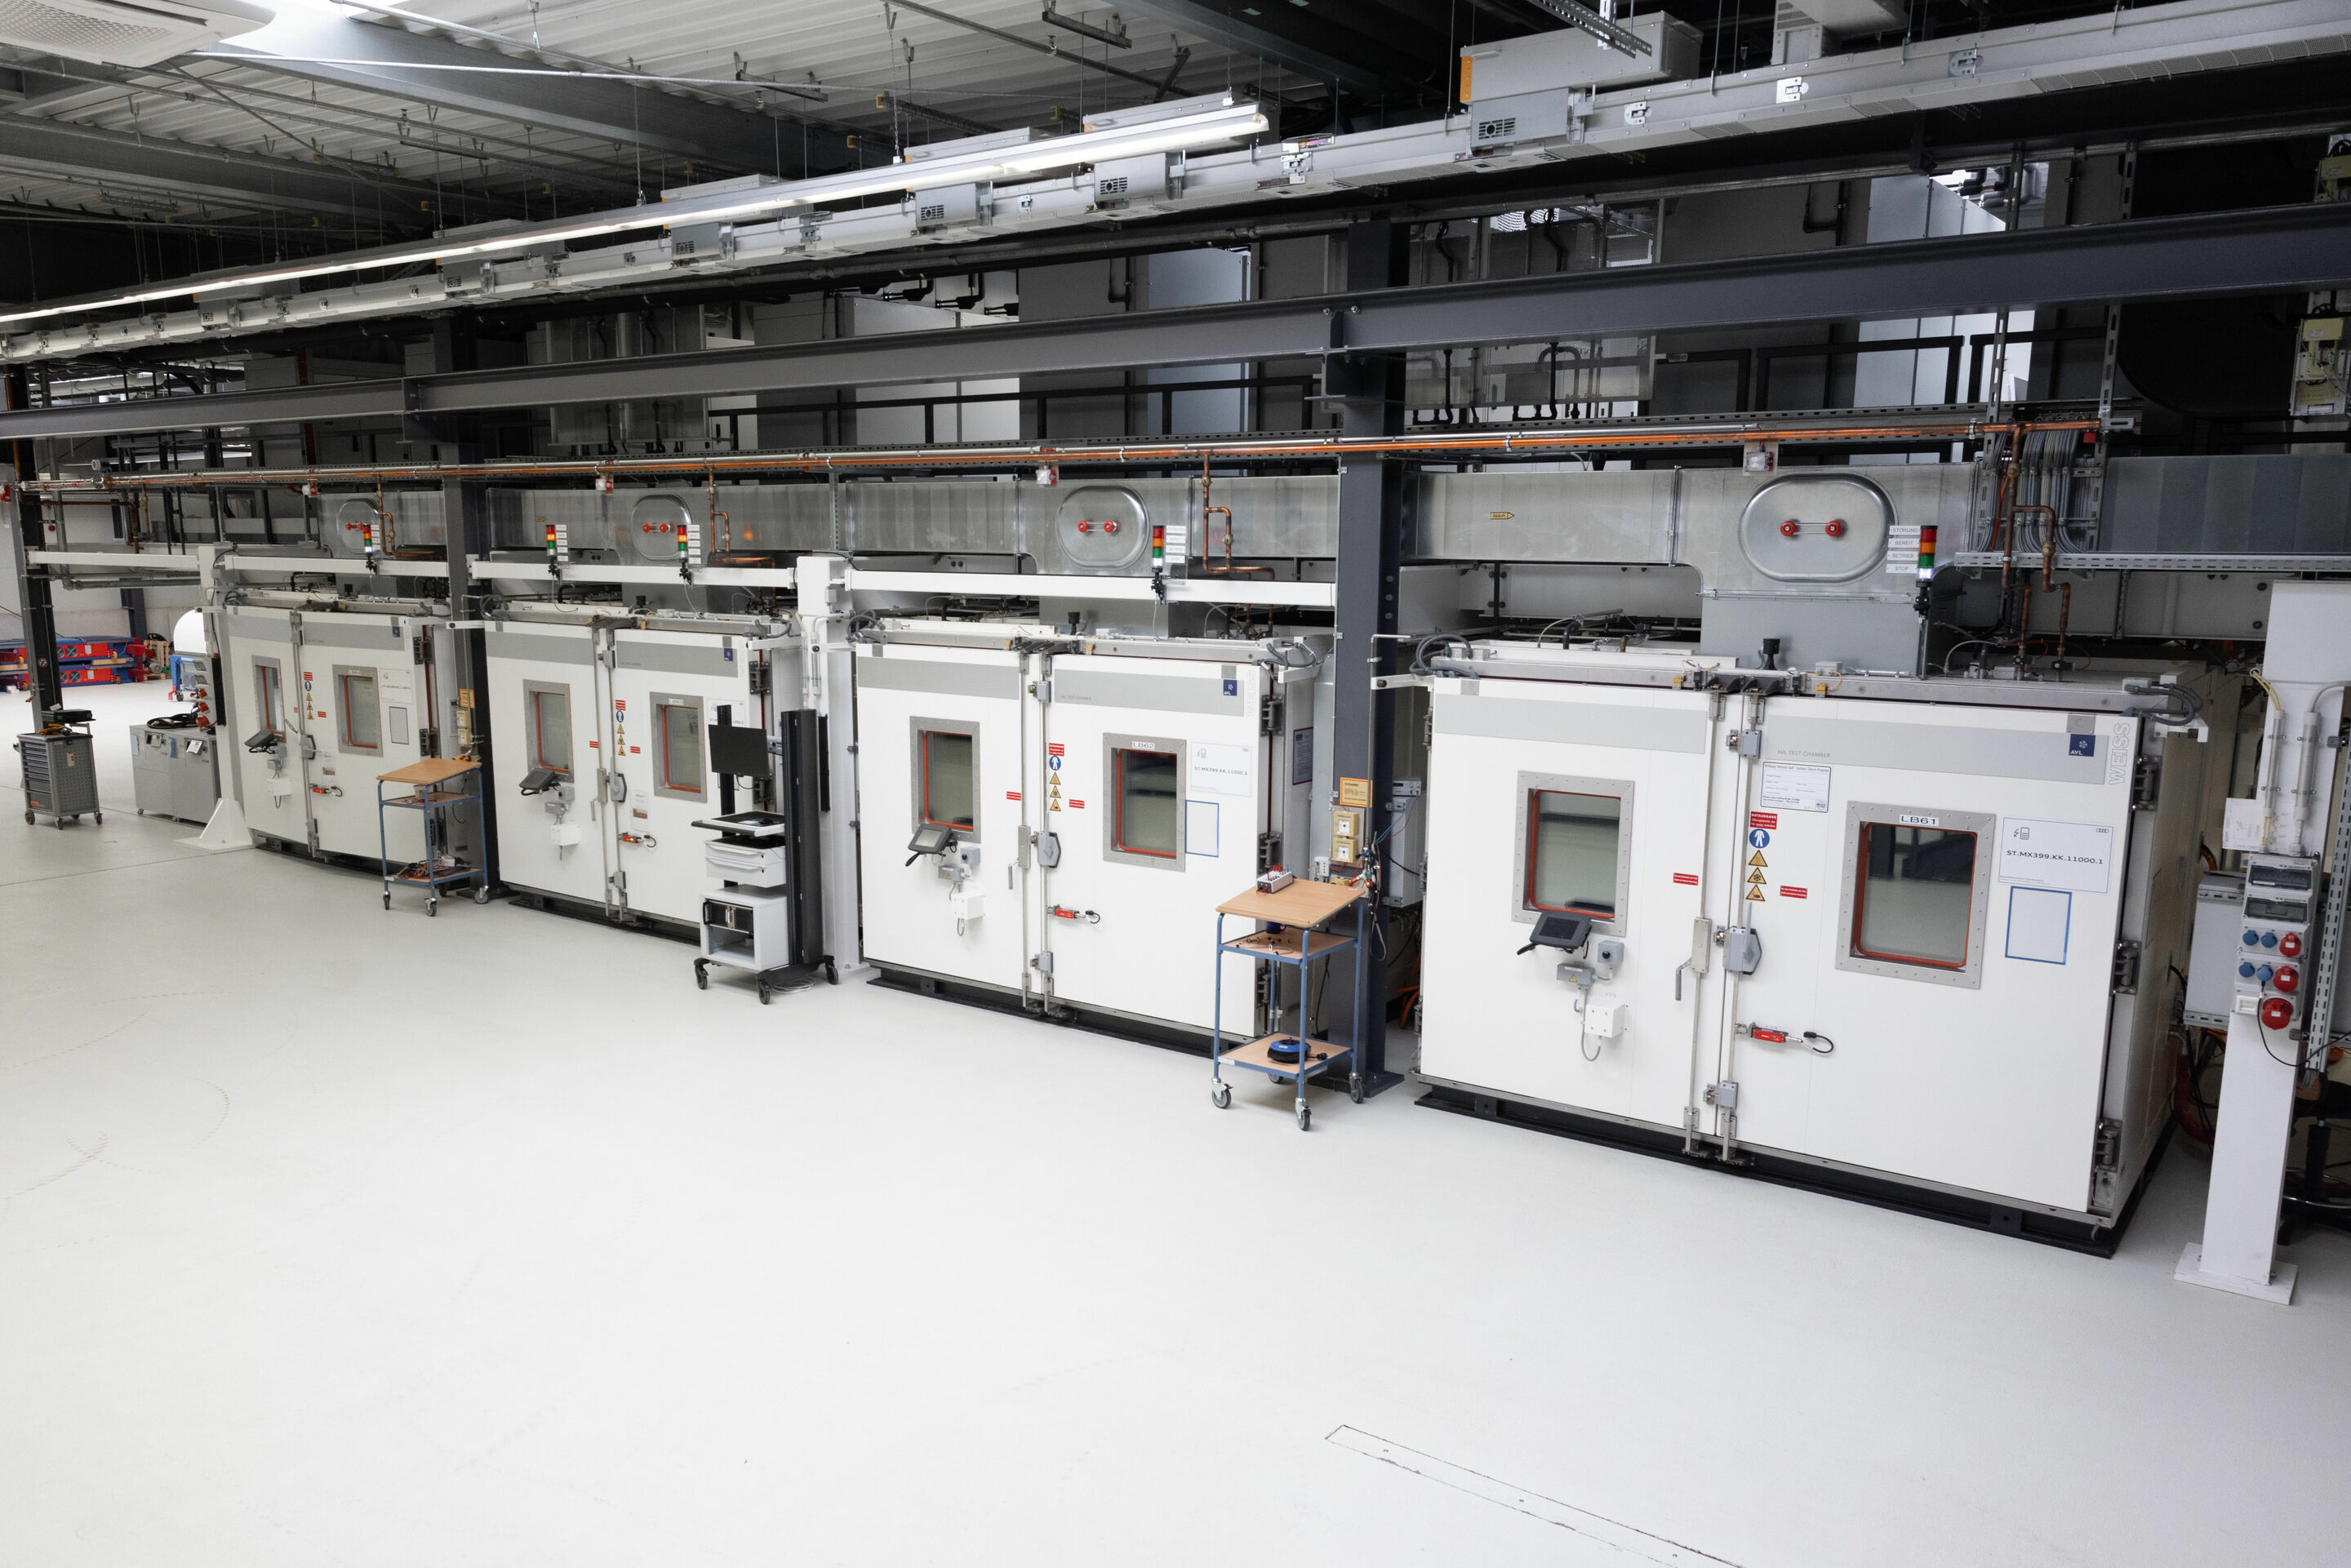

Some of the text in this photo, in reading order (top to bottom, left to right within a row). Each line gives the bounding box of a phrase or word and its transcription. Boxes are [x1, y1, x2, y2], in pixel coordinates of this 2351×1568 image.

[2109, 723, 2130, 784] WEISS
[1901, 815, 1935, 824] LB61
[2007, 850, 2104, 864] ST.MX399.KK.11000.1
